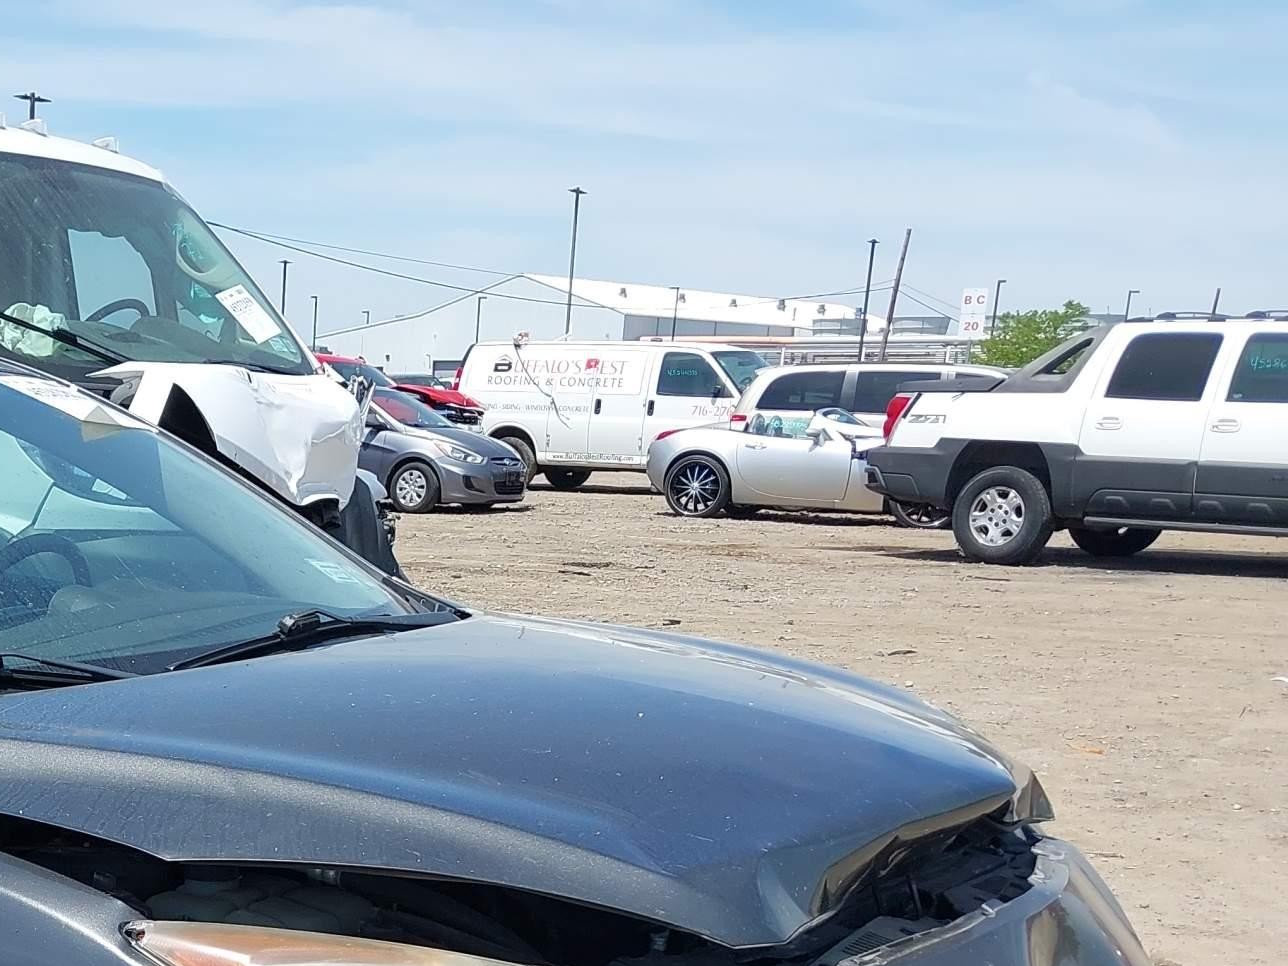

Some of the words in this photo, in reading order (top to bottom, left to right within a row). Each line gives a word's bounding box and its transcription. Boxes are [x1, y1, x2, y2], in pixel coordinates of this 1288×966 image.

[963, 321, 979, 331] 20
[487, 375, 540, 386] ROOFING
[559, 376, 624, 388] CONCRETE
